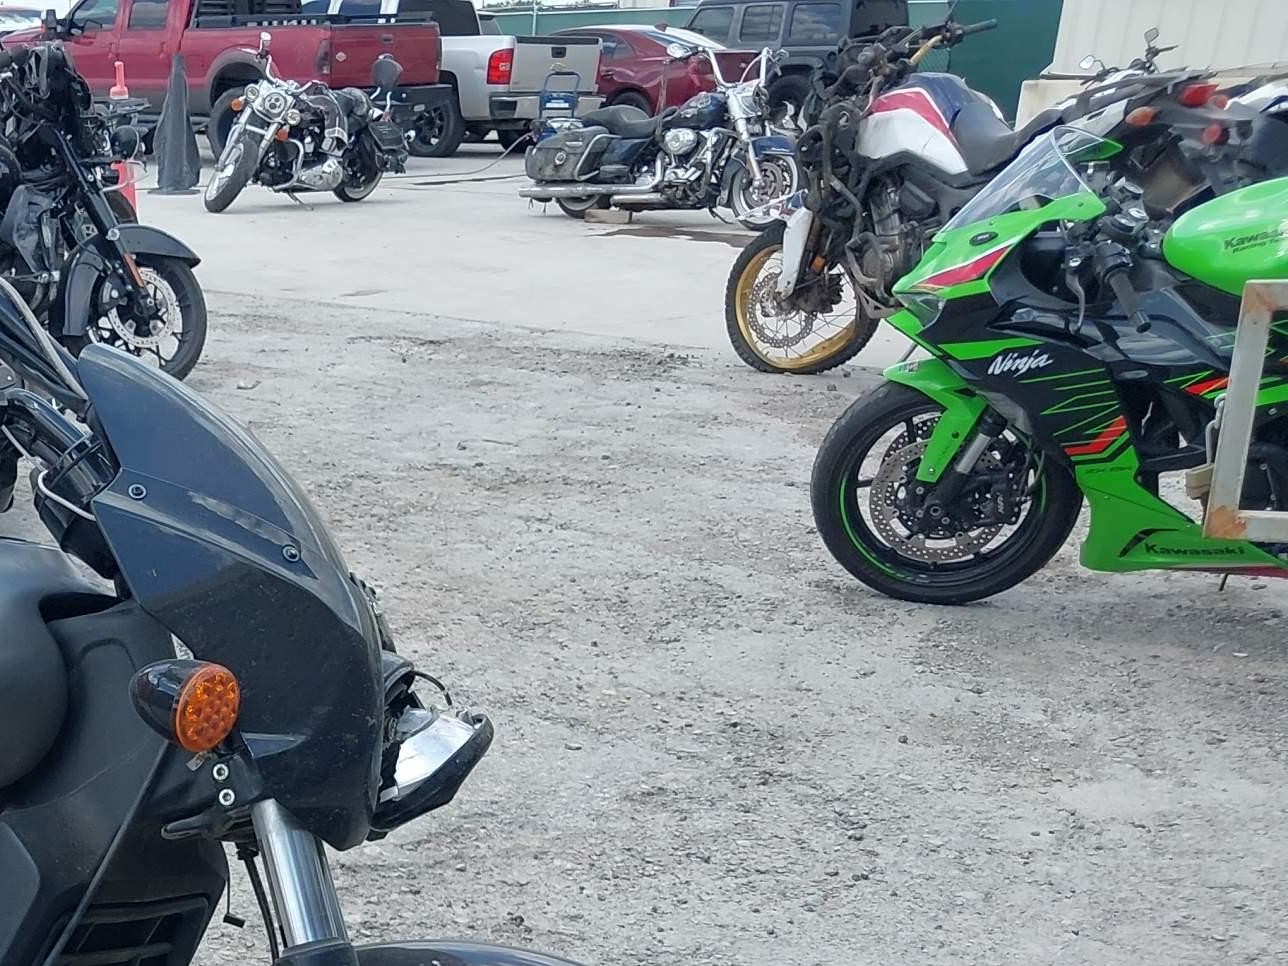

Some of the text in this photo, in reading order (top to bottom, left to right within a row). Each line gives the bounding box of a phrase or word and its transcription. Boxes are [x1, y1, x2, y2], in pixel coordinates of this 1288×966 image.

[1224, 229, 1284, 250] Kawa
[987, 349, 1054, 378] Ninja
[1144, 543, 1245, 555] Kawasaki
